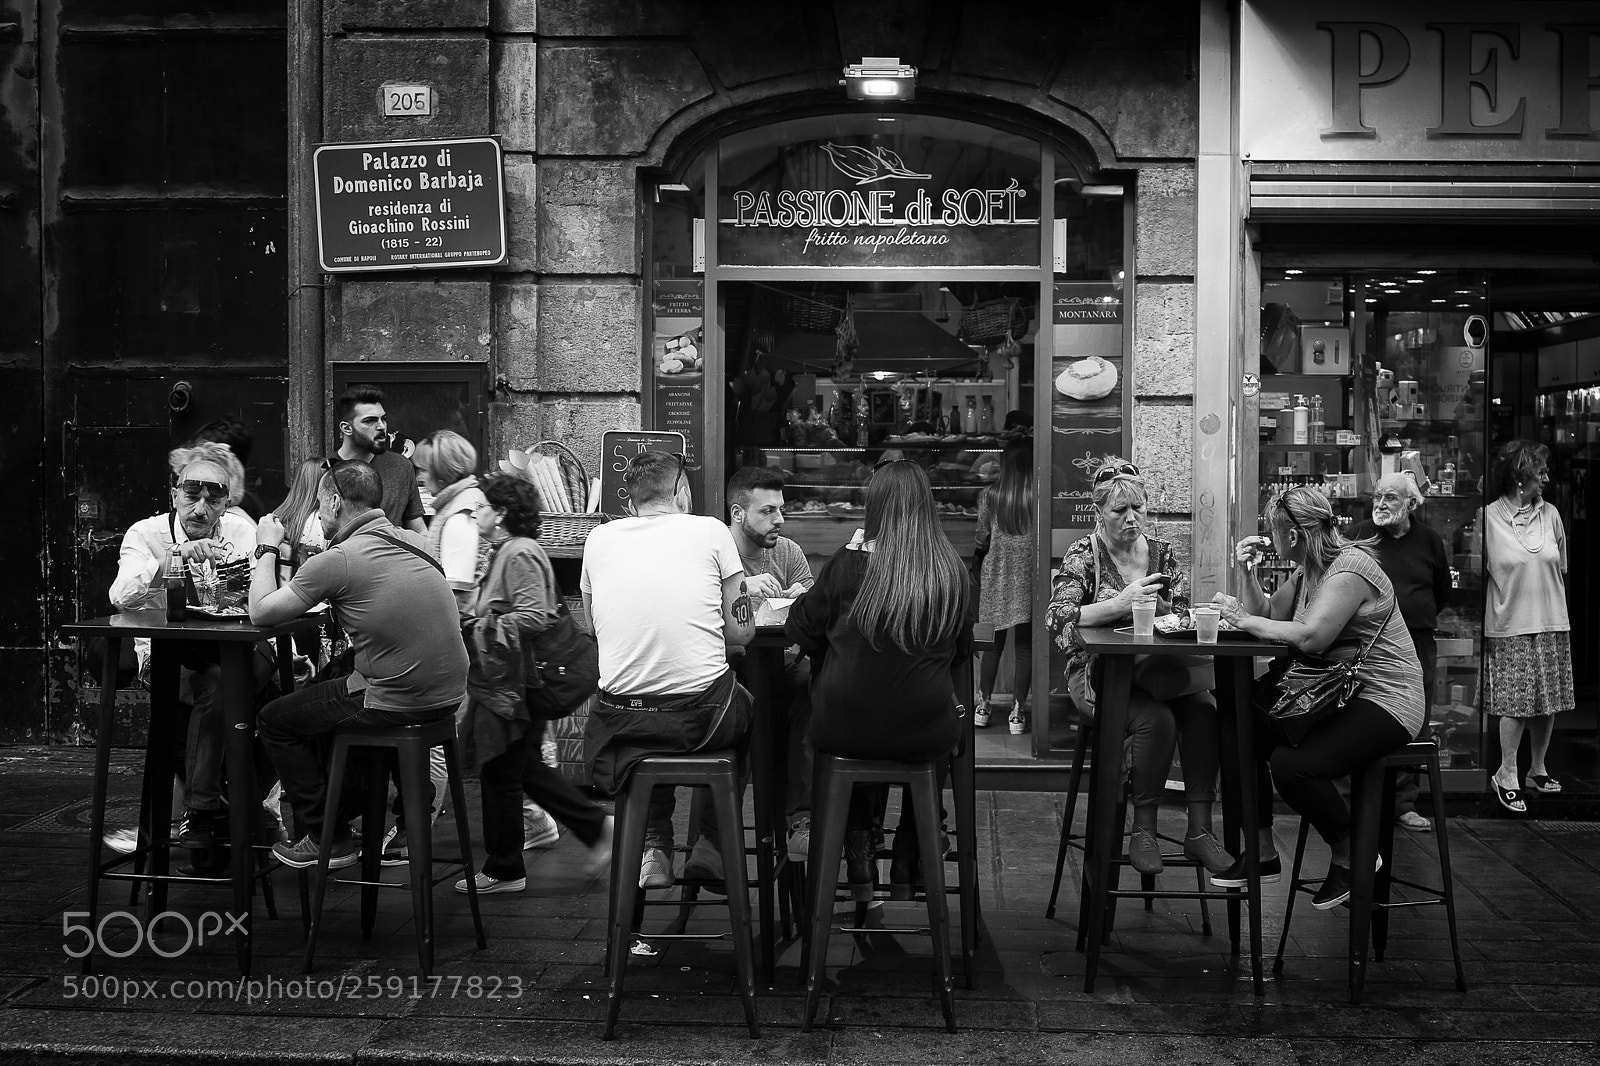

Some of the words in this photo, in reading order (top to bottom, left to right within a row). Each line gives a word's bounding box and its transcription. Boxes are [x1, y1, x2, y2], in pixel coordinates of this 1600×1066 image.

[390, 92, 425, 110] 205
[362, 151, 428, 171] Palazzo
[436, 148, 451, 167] di
[333, 173, 413, 194] Domenico
[419, 169, 484, 192] Barbaja
[368, 201, 432, 217] residenza
[439, 198, 452, 213] di
[733, 190, 896, 228] PASSIONE
[905, 188, 933, 227] di
[349, 218, 414, 235] Gioachino
[421, 214, 470, 232] Rossini
[381, 238, 410, 250] (1815
[425, 236, 443, 248] 22)
[803, 227, 850, 254] fritto
[853, 227, 950, 254] napoletano
[390, 253, 409, 261] ROTARY
[409, 252, 443, 260] INTERNATIONAL
[1059, 310, 1118, 319] MONTANARA
[1075, 504, 1097, 512] PIZZ
[1071, 514, 1098, 522] FRITT
[735, 604, 748, 622] 10
